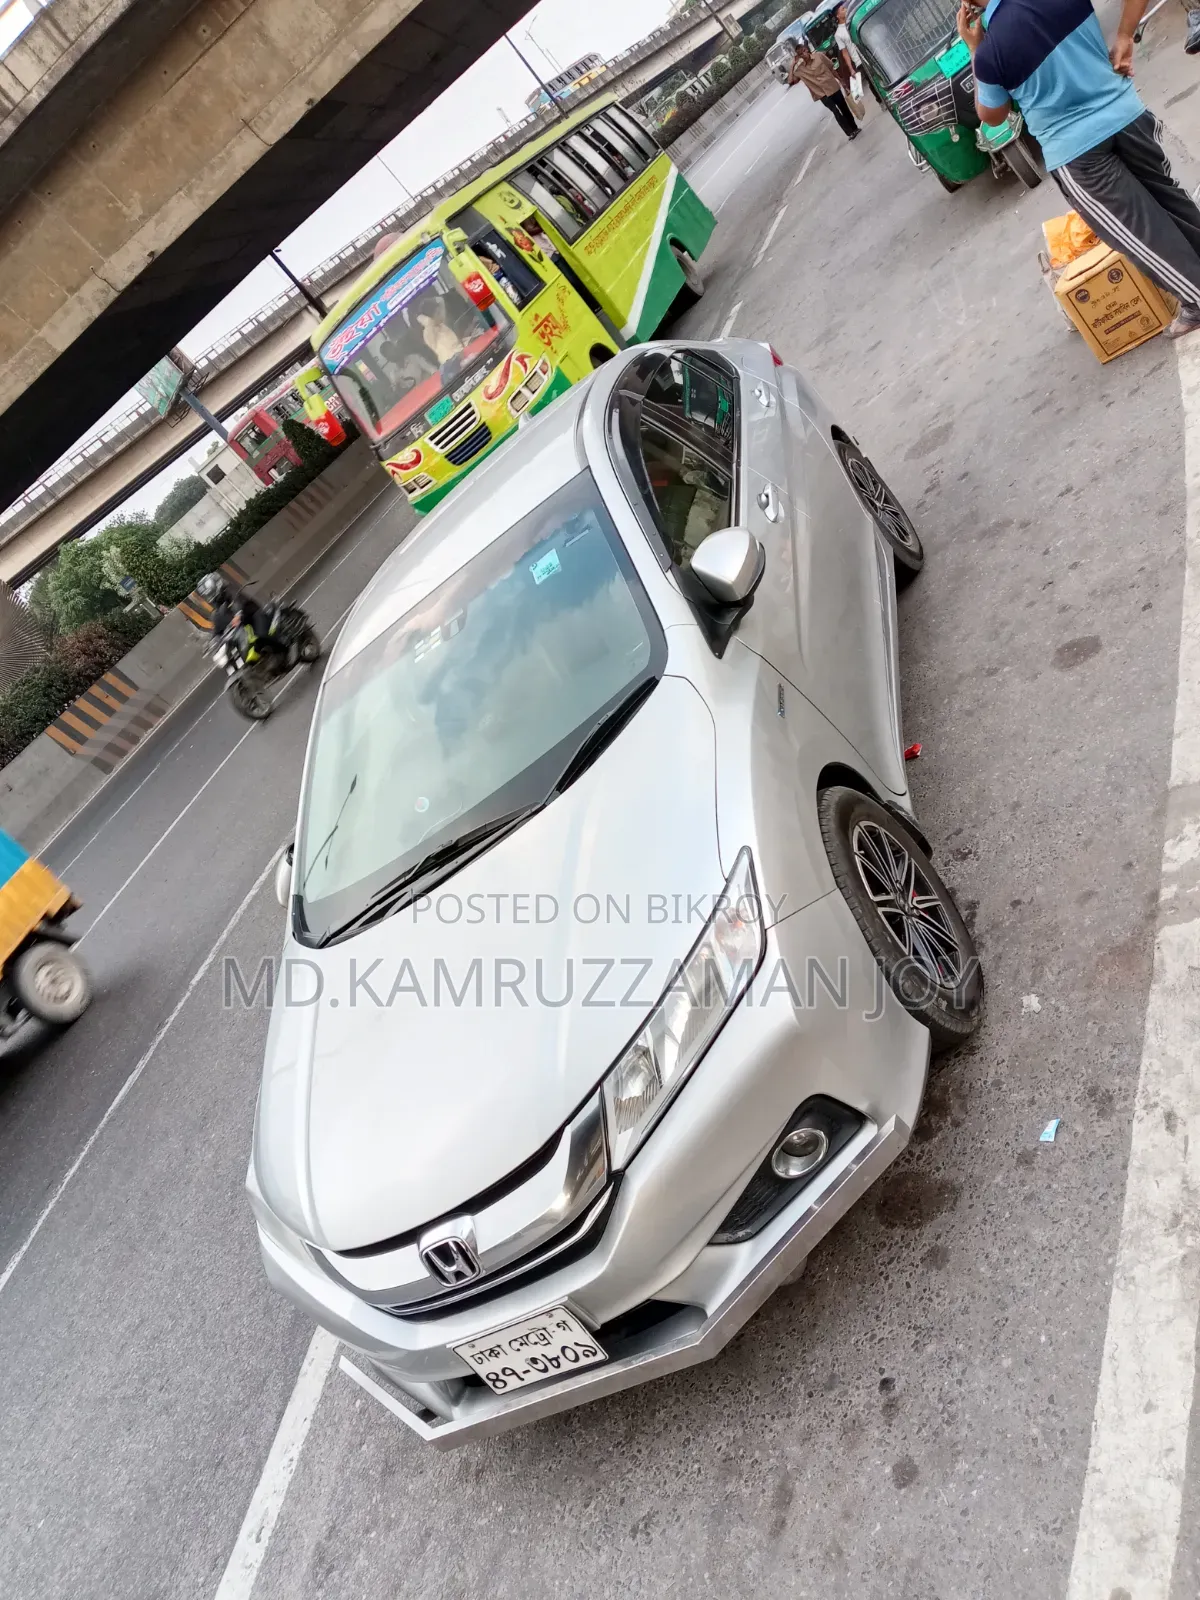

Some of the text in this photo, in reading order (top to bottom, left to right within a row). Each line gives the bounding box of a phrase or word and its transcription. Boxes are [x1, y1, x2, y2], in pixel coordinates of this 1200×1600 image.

[469, 1319, 574, 1366] ঢাকা মেট্রো-গ
[485, 1341, 598, 1389] ৪৭-৩৮০৯
